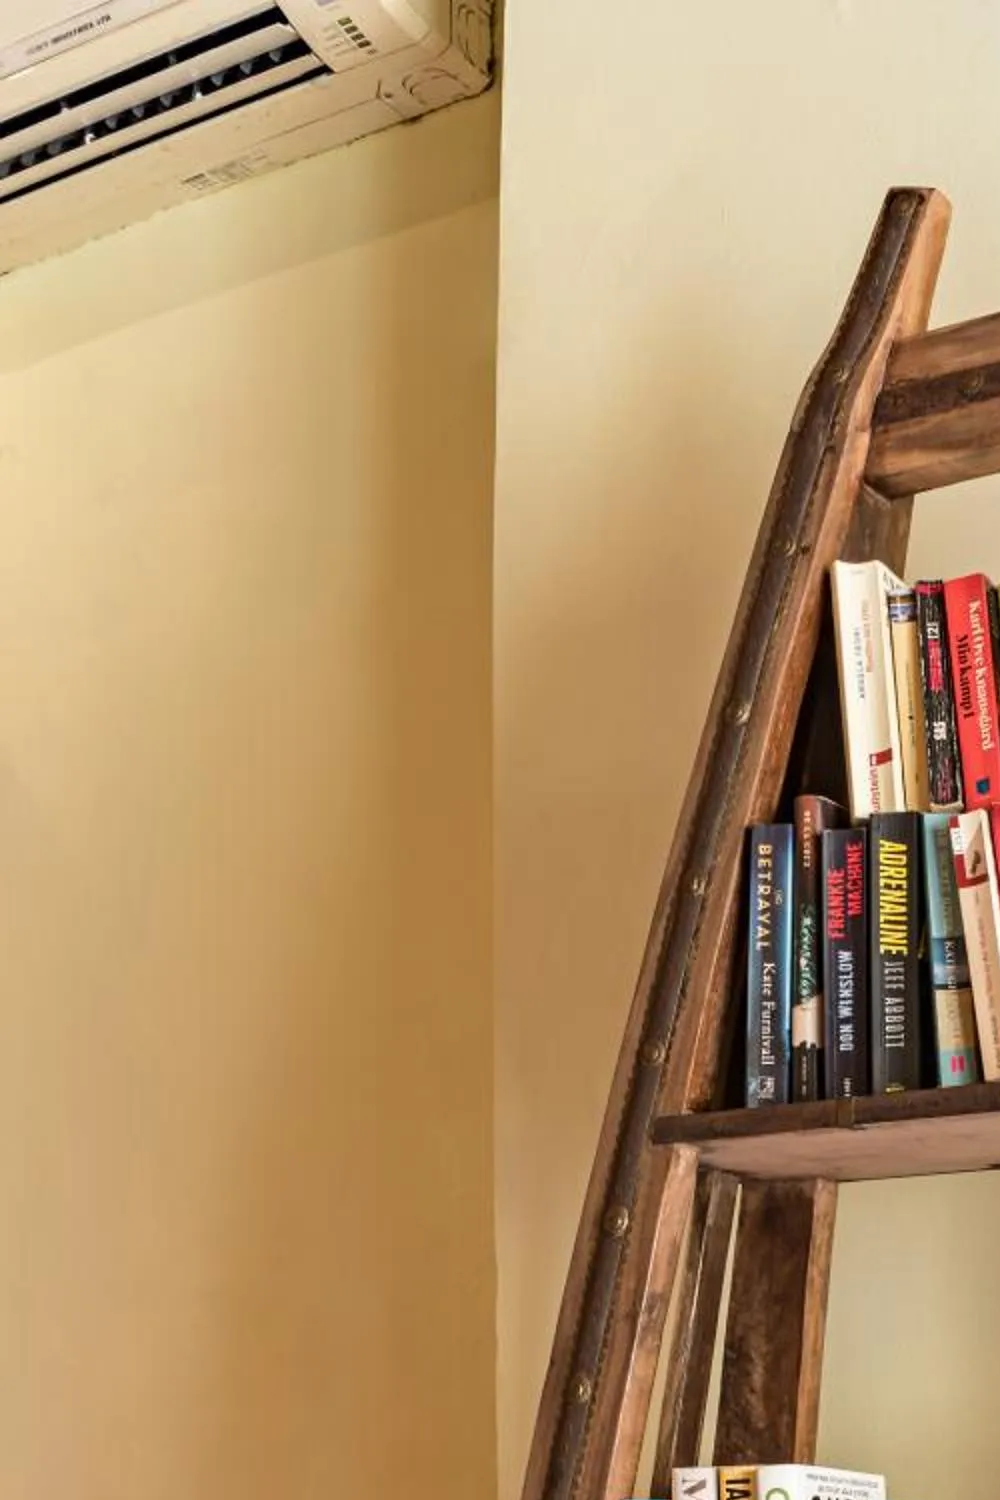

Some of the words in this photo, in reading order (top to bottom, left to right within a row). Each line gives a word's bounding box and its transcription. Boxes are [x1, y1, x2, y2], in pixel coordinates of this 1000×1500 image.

[756, 844, 773, 951] BETRAYAL
[828, 867, 846, 940] FRANKIE
[847, 842, 864, 918] MACHINE
[879, 839, 909, 957] ADRENALINE
[761, 961, 777, 996] Kate
[839, 950, 855, 1019] WINSLOW
[884, 961, 905, 989] JEFF
[760, 1001, 777, 1066] Furnivall
[839, 1025, 855, 1052] DON
[884, 997, 905, 1049] ABBOTT
